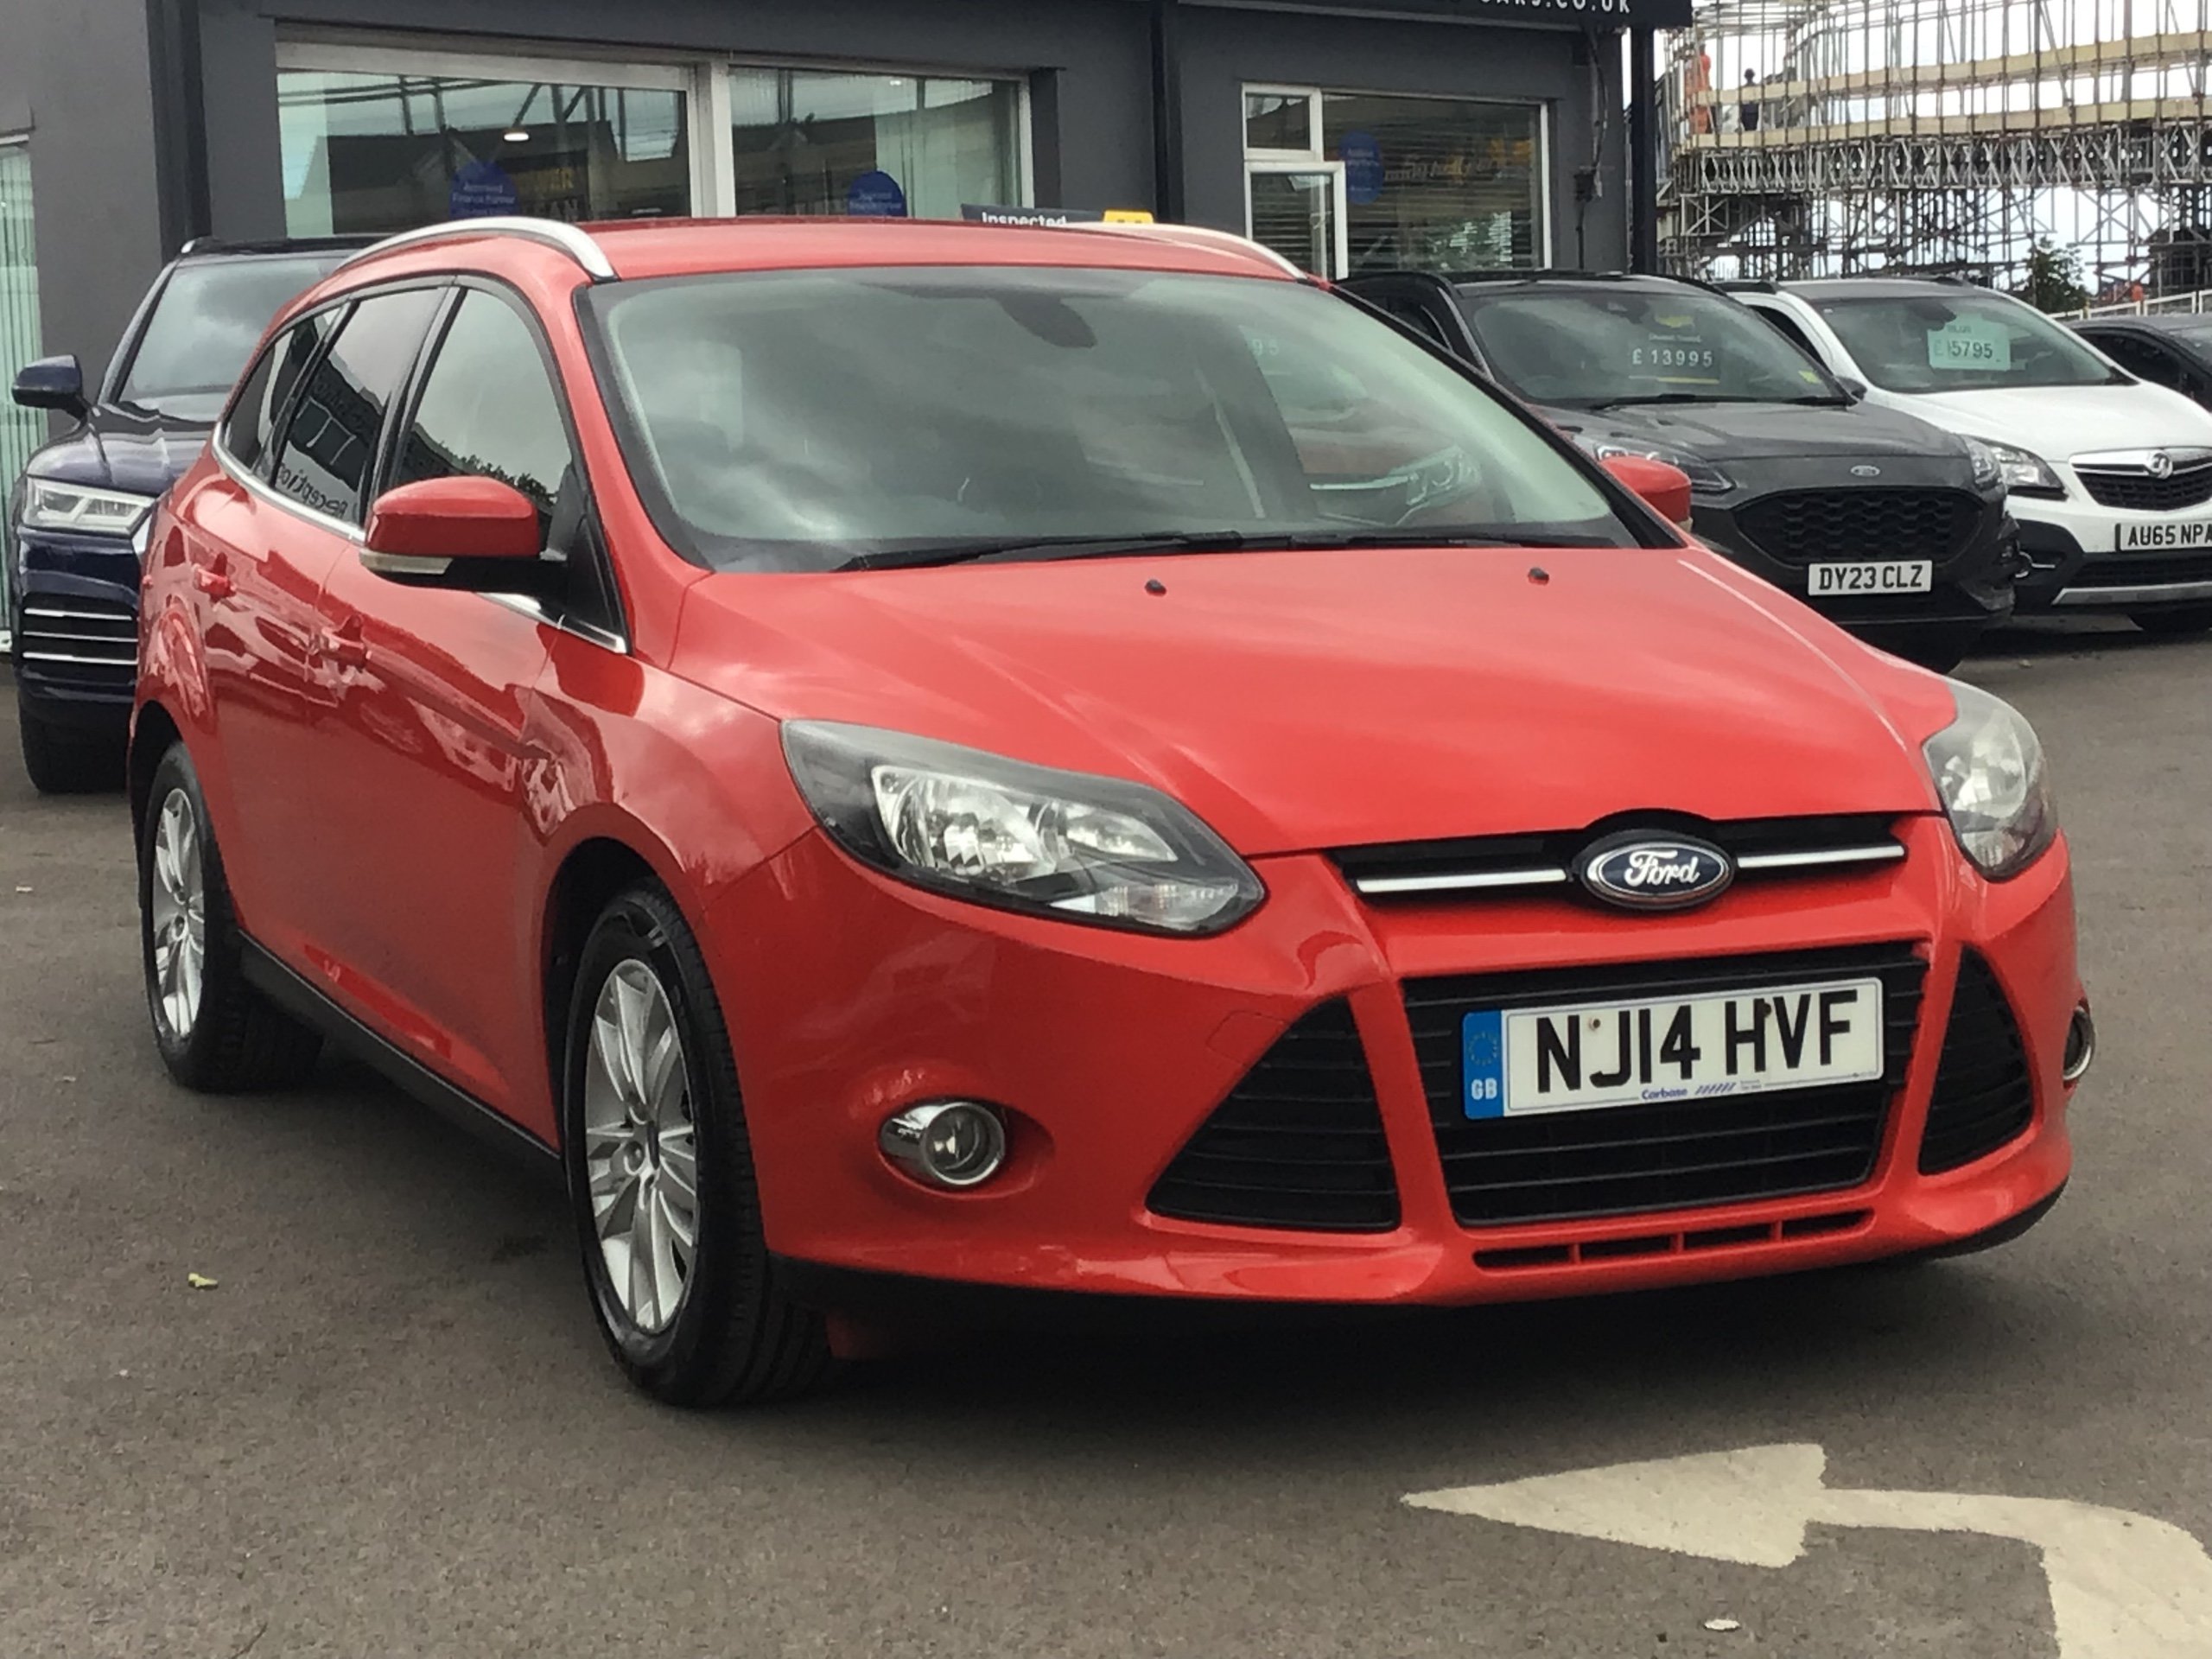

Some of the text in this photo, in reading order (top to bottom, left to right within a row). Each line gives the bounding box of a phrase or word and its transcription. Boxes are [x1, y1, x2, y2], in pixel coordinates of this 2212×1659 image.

[2127, 523, 2212, 546] AU65 NPA
[1819, 564, 1923, 590] DY23 CLZ
[1624, 850, 1700, 887] Ford
[1536, 989, 1858, 1094] NJ14 HVF
[1471, 1078, 1498, 1100] GB
